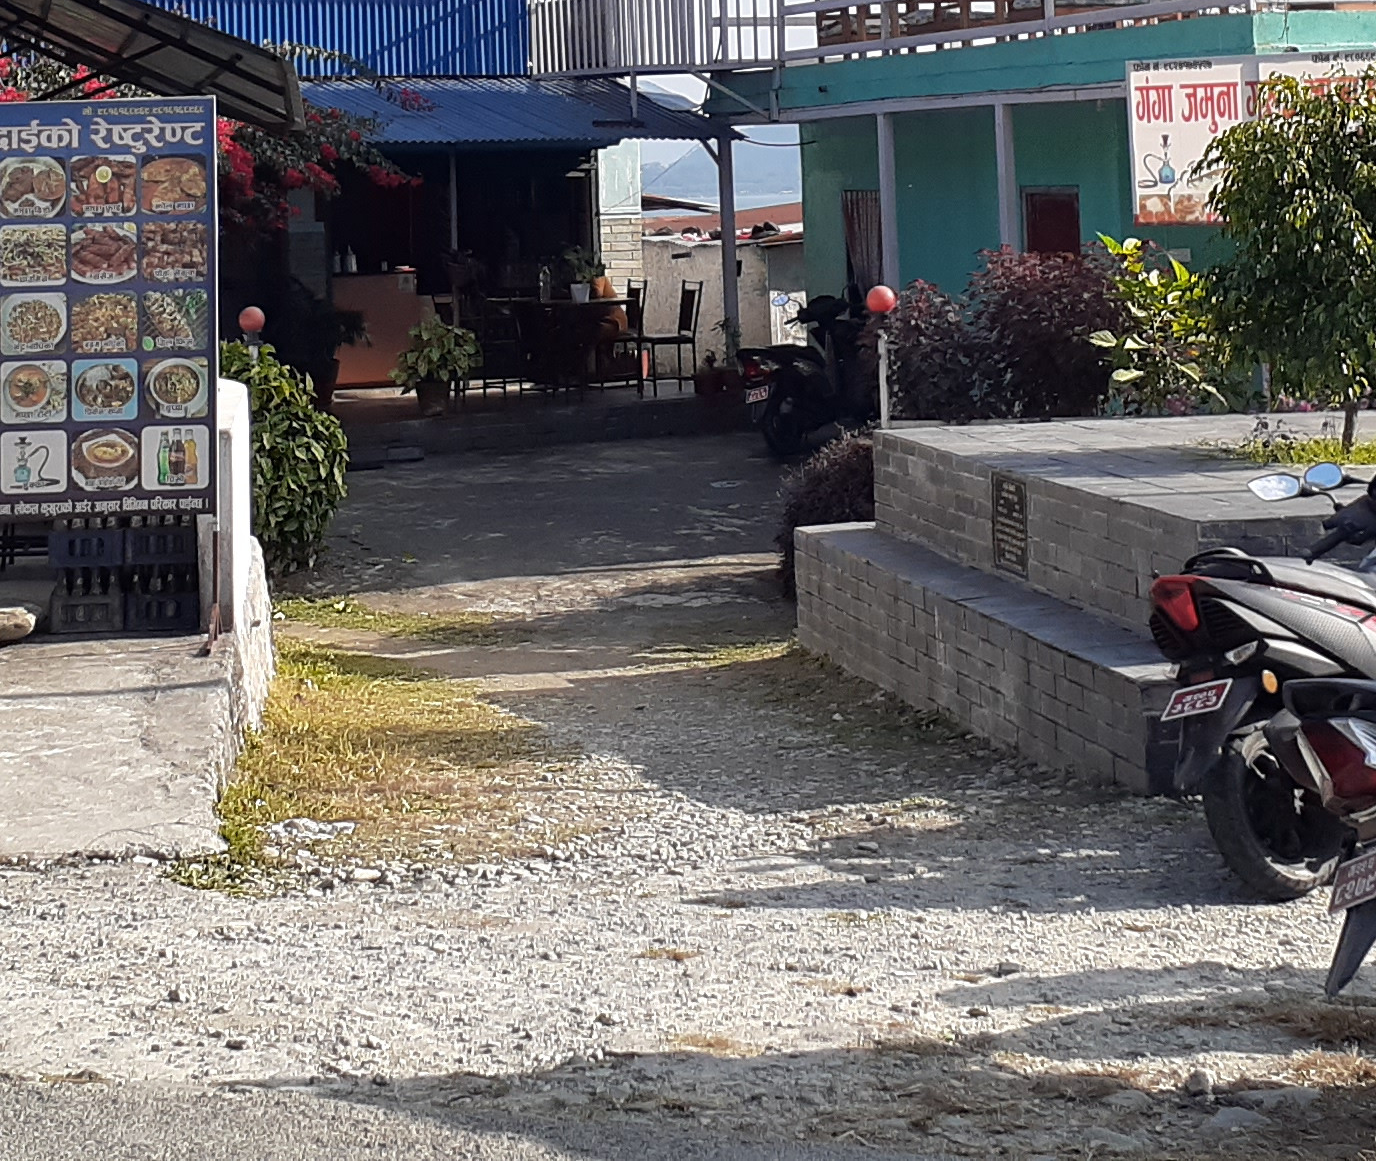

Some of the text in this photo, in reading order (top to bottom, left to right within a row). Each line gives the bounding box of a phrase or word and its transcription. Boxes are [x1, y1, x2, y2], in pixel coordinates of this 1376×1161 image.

[1135, 76, 1173, 123] गंगा
[1179, 82, 1239, 134] जमुना
[90, 116, 205, 153] रेष्टुरेण्ट
